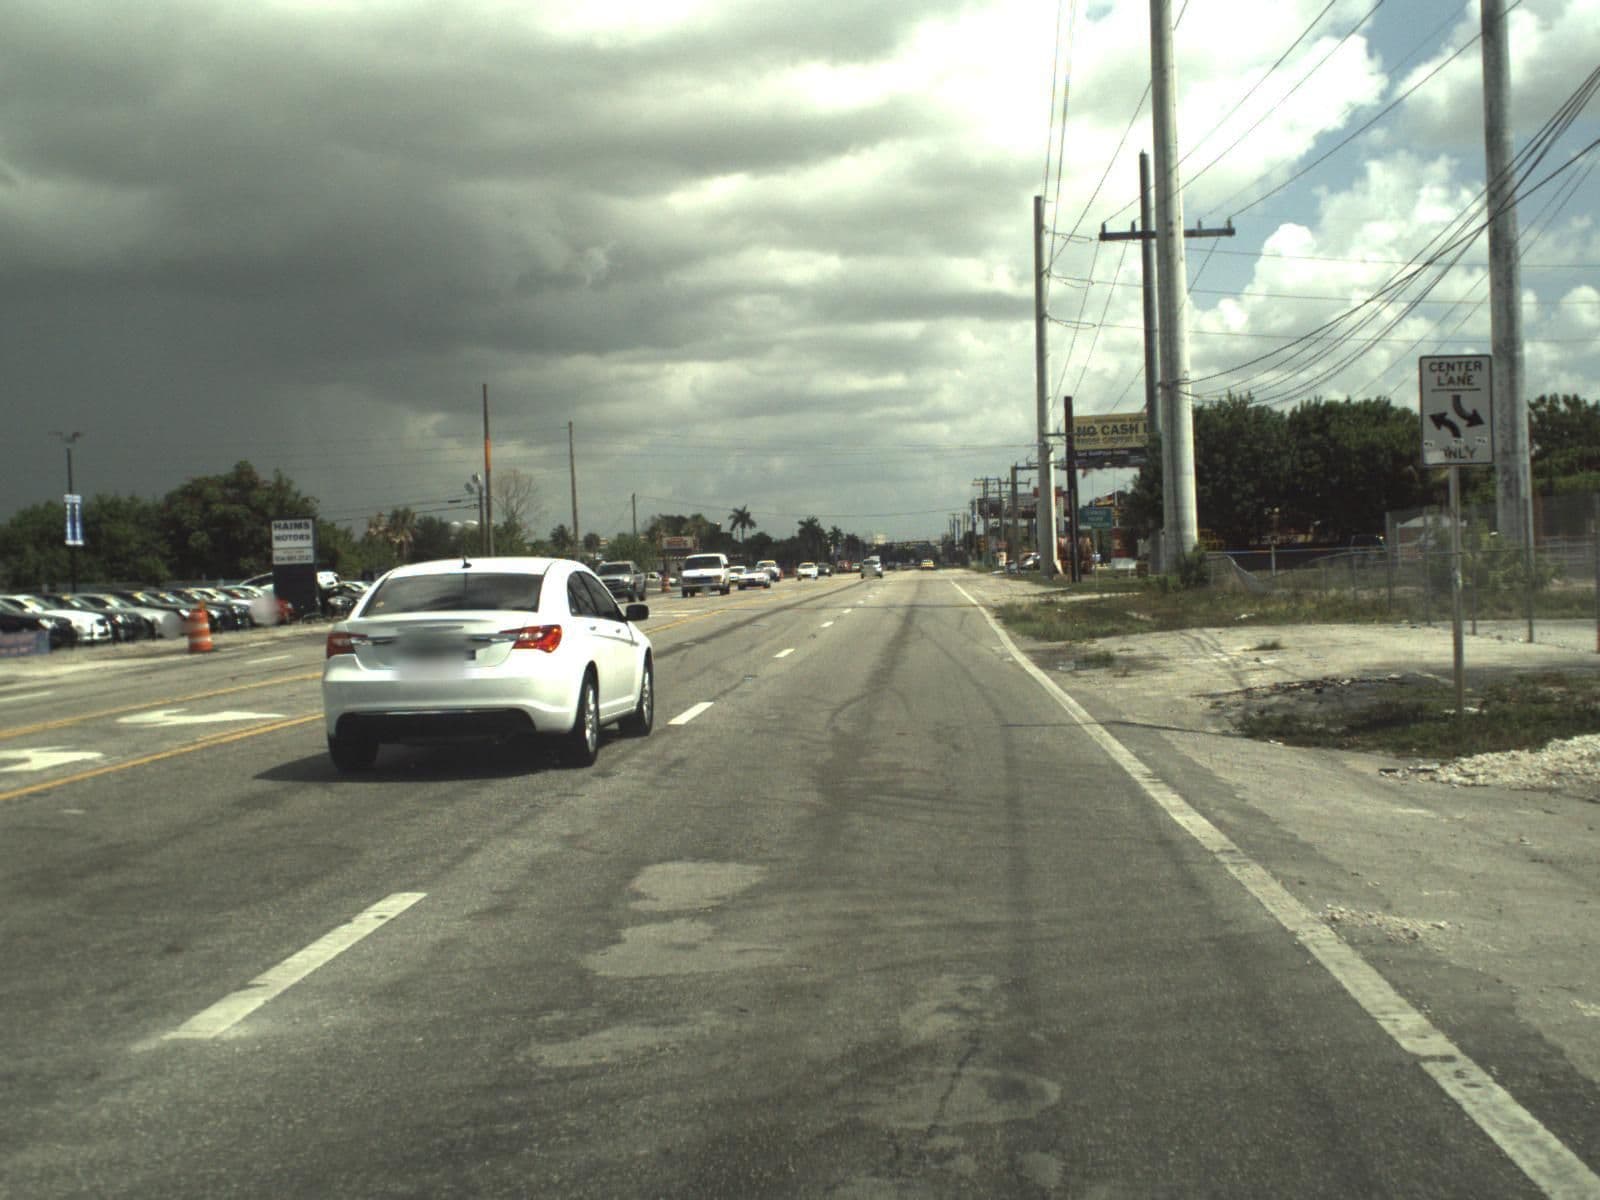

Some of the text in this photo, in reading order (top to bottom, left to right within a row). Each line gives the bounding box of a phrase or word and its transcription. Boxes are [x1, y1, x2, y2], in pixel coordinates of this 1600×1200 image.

[1428, 361, 1482, 373] CENTER
[1437, 374, 1474, 386] LANE
[1101, 423, 1139, 436] CASH
[1441, 446, 1477, 460] NLY
